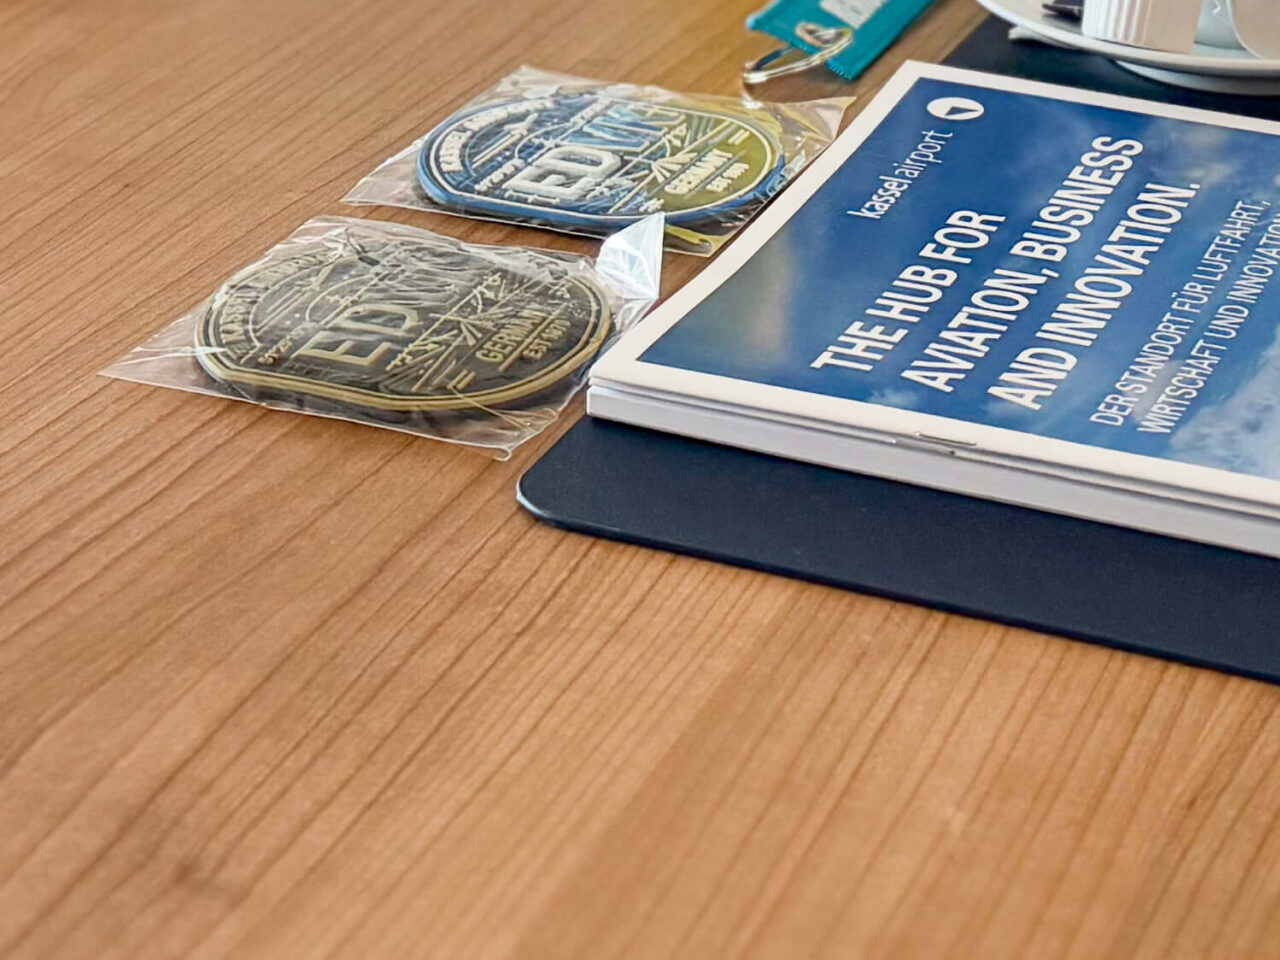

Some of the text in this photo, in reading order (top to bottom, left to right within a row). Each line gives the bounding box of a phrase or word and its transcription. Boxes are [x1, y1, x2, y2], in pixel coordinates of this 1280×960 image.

[664, 148, 733, 195] GERMANY
[847, 129, 953, 219] kassel airport
[810, 210, 1007, 371] THE HUB FOR
[900, 136, 1144, 393] AVIATION, BUSINESS
[987, 182, 1200, 411] AND INNOVATION.
[1089, 200, 1271, 426] DER STANDORT FÜR LUFTFAHRT,
[523, 339, 552, 360] EST
[1136, 339, 1227, 433] WIRTSCHAFT
[1204, 304, 1249, 339] UND
